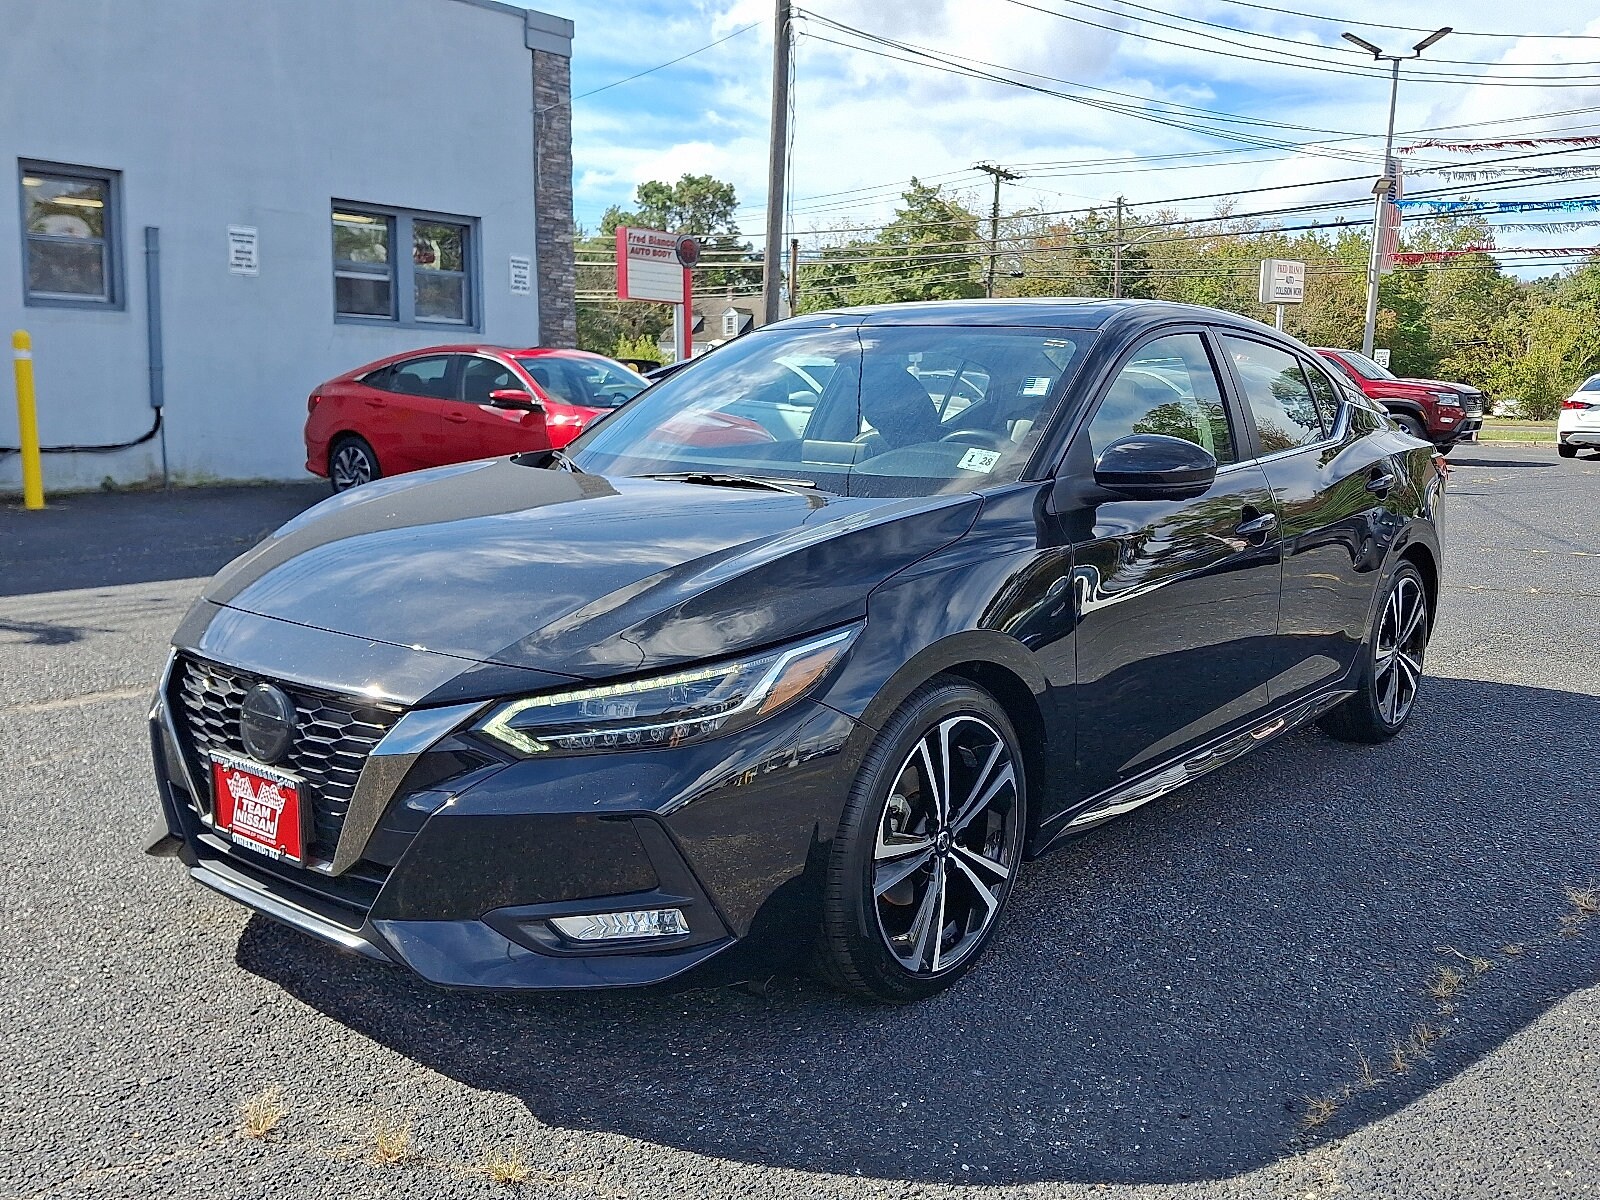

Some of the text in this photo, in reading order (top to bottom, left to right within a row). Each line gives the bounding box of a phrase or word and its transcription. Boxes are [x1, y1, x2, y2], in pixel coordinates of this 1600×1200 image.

[628, 233, 646, 244] Fred
[630, 247, 672, 258] AUTO BODY
[1277, 264, 1288, 274] FRED
[968, 454, 976, 462] 1
[979, 456, 993, 466] 28
[241, 799, 271, 818] TEAM
[236, 810, 274, 834] NISSAN
[268, 849, 280, 861] NJ
